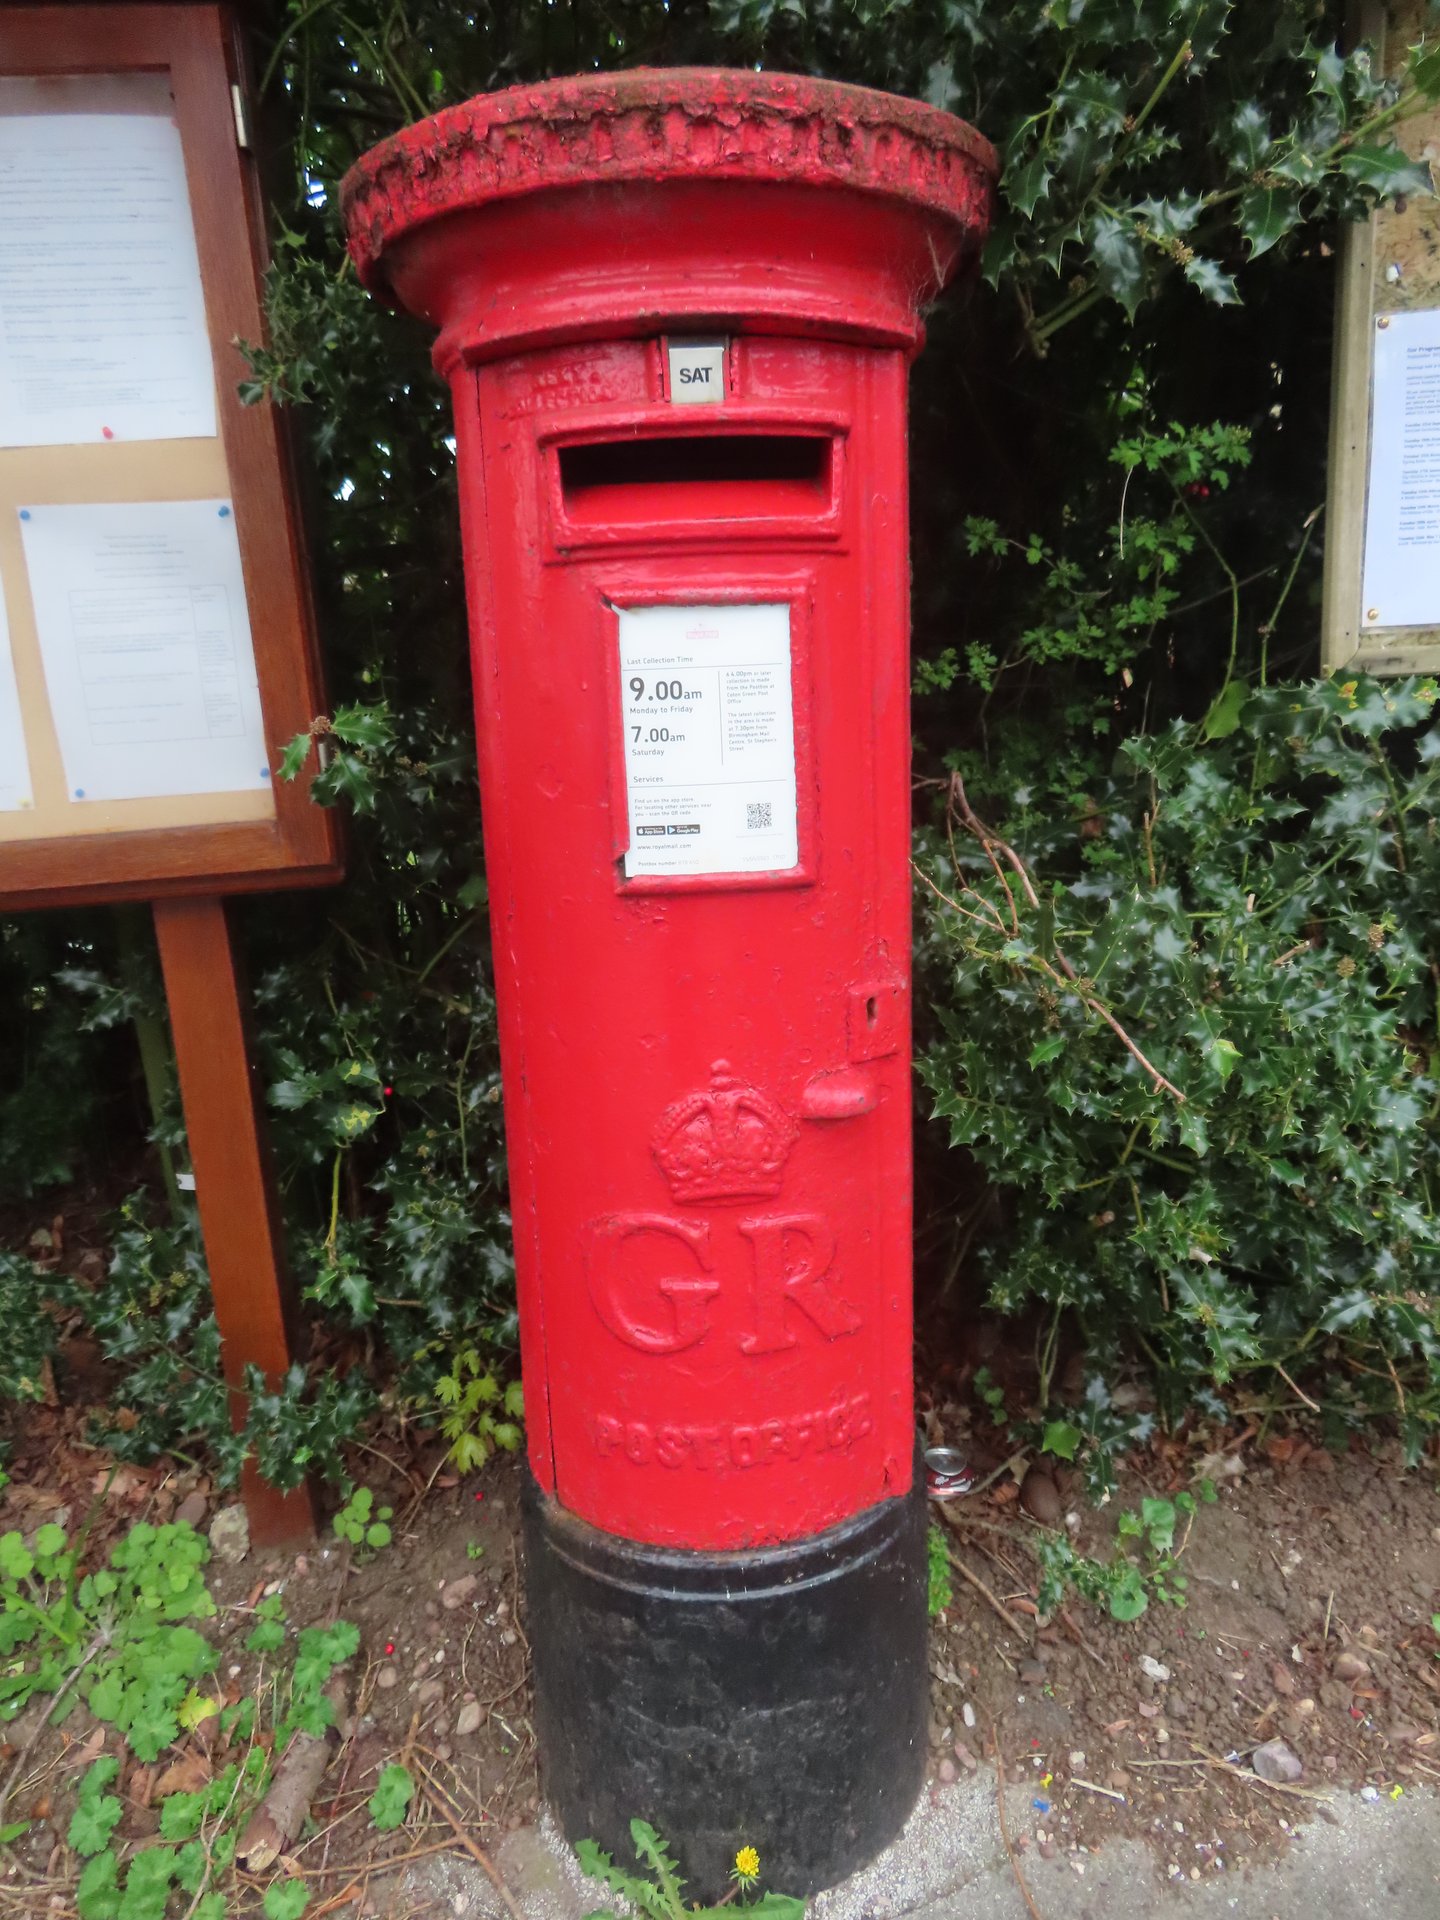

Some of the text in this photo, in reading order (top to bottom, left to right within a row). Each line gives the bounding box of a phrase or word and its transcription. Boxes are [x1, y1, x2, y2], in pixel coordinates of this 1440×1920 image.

[679, 367, 713, 384] SAT
[643, 656, 675, 664] Collection
[630, 677, 702, 702] 9.00am
[630, 707, 658, 715] Monday
[630, 726, 685, 743] 7.00am
[633, 775, 664, 783] Services
[595, 1396, 872, 1471] POST OFFICE
